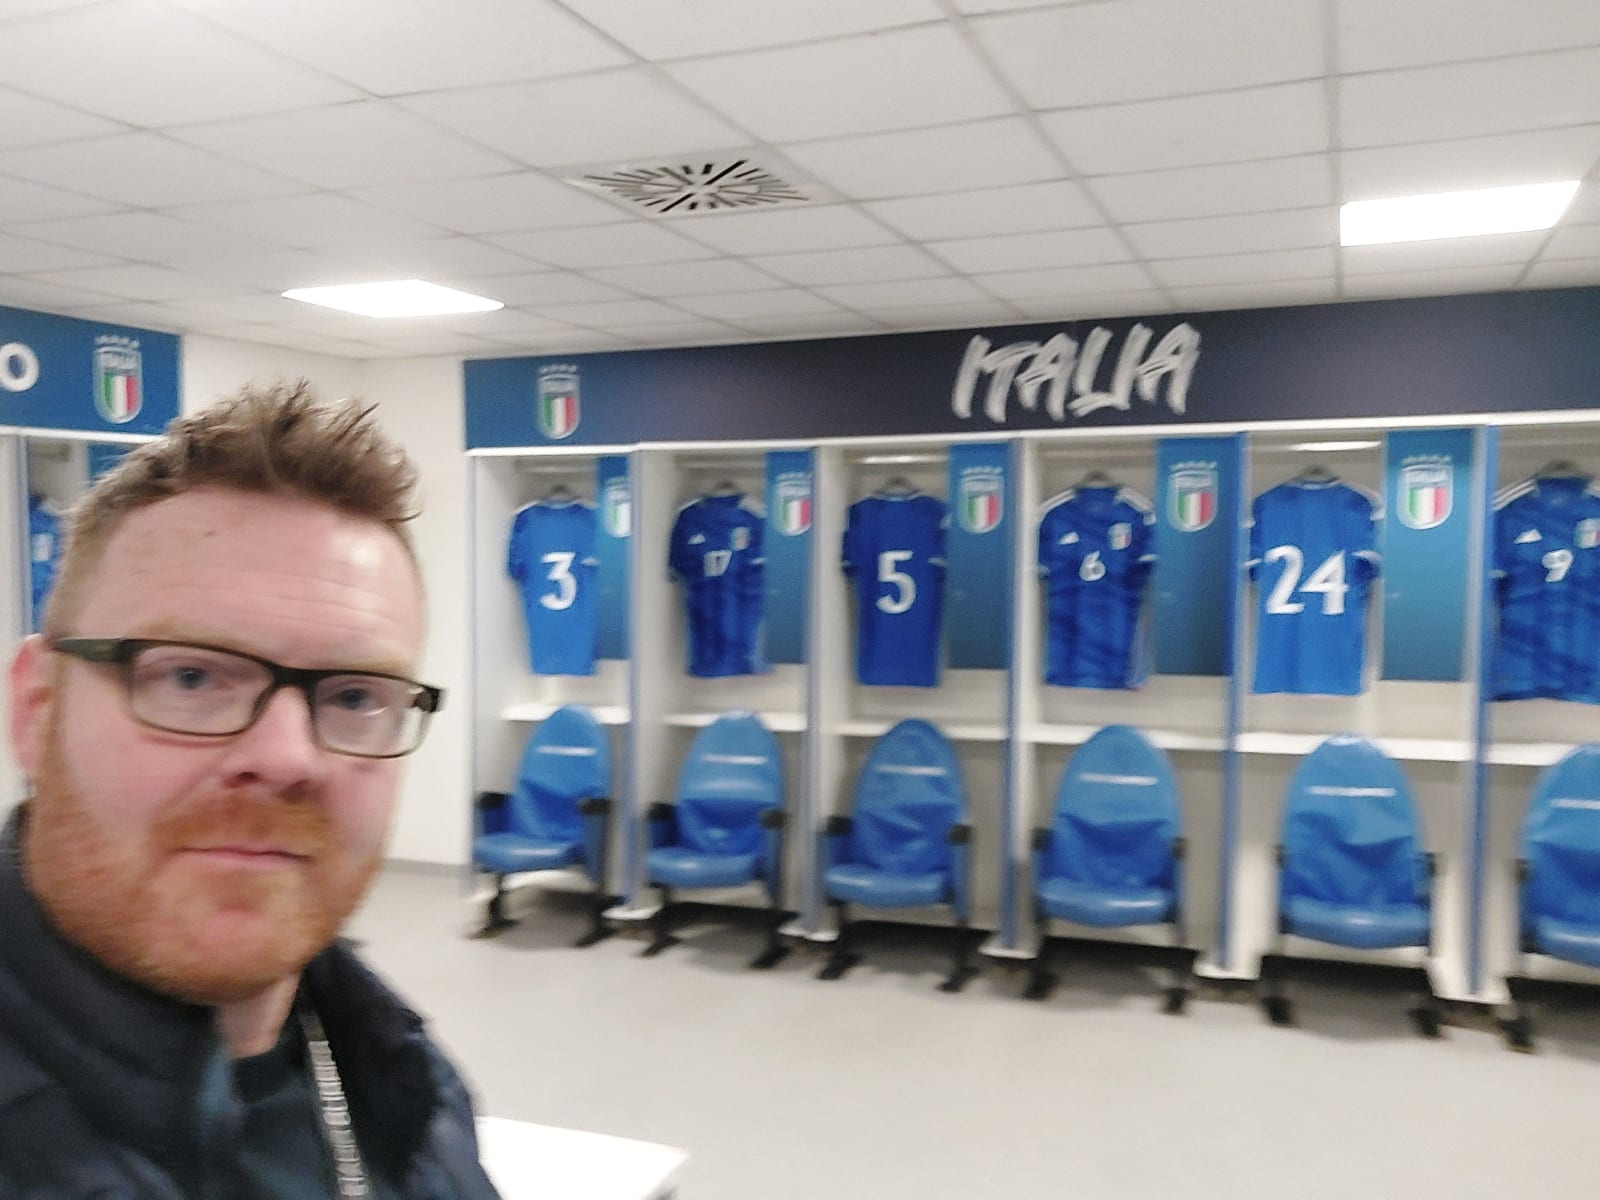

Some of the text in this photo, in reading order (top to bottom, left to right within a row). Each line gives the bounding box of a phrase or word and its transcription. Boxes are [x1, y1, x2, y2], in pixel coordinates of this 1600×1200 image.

[952, 322, 1201, 423] ITALIA
[539, 551, 578, 611] 3
[703, 550, 733, 577] 17
[875, 549, 916, 614] 5
[1079, 550, 1106, 582] 6
[1263, 544, 1349, 616] 24
[1541, 549, 1574, 583] 9
